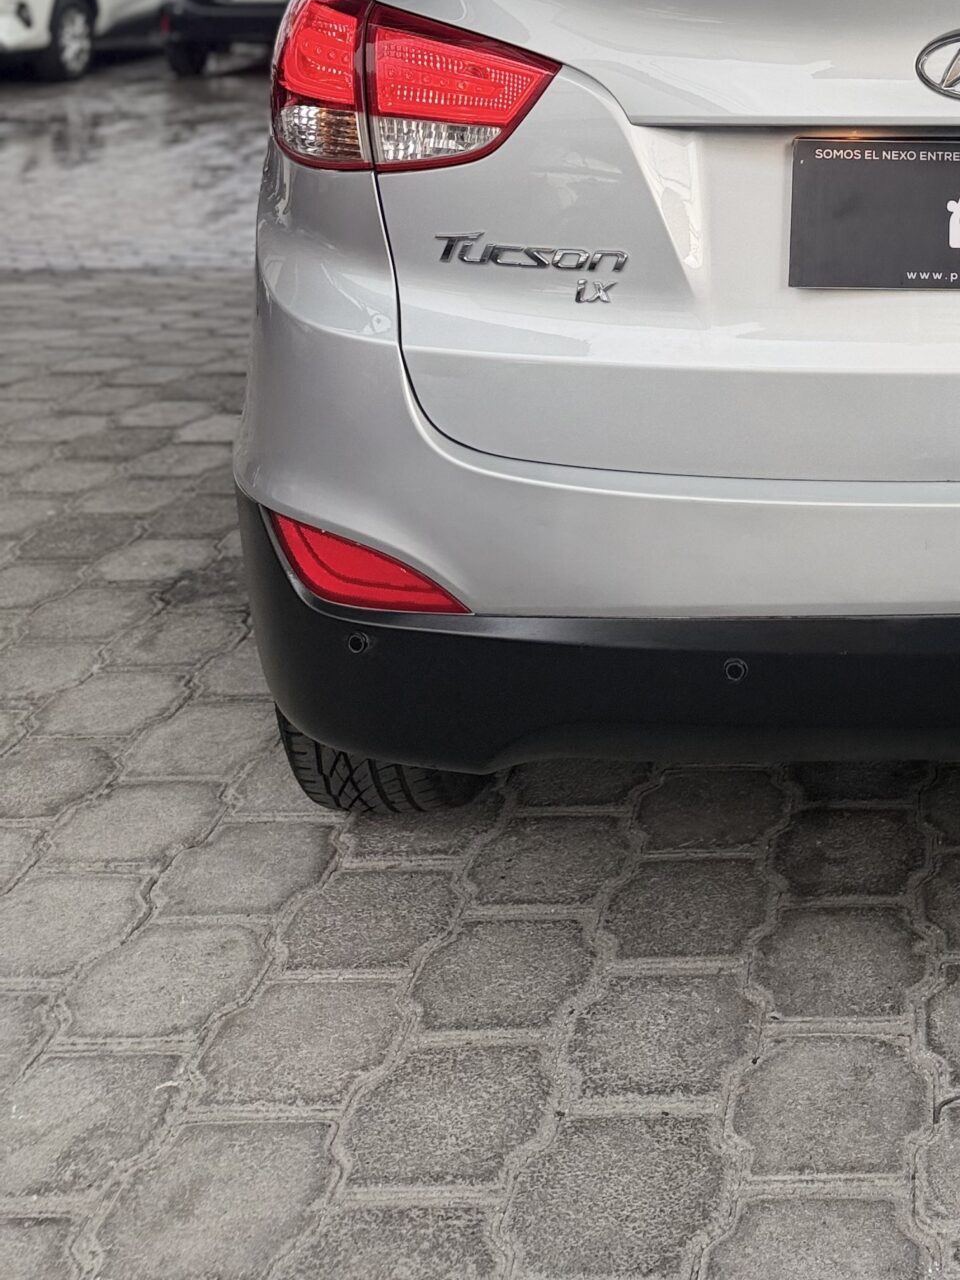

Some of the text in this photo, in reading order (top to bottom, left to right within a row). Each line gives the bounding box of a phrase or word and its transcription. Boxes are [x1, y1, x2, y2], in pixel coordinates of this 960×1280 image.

[815, 148, 861, 160] SOMOS
[864, 150, 879, 160] EL
[882, 150, 917, 161] NEXO
[919, 151, 960, 162] ENTRE
[435, 231, 628, 272] Tucson
